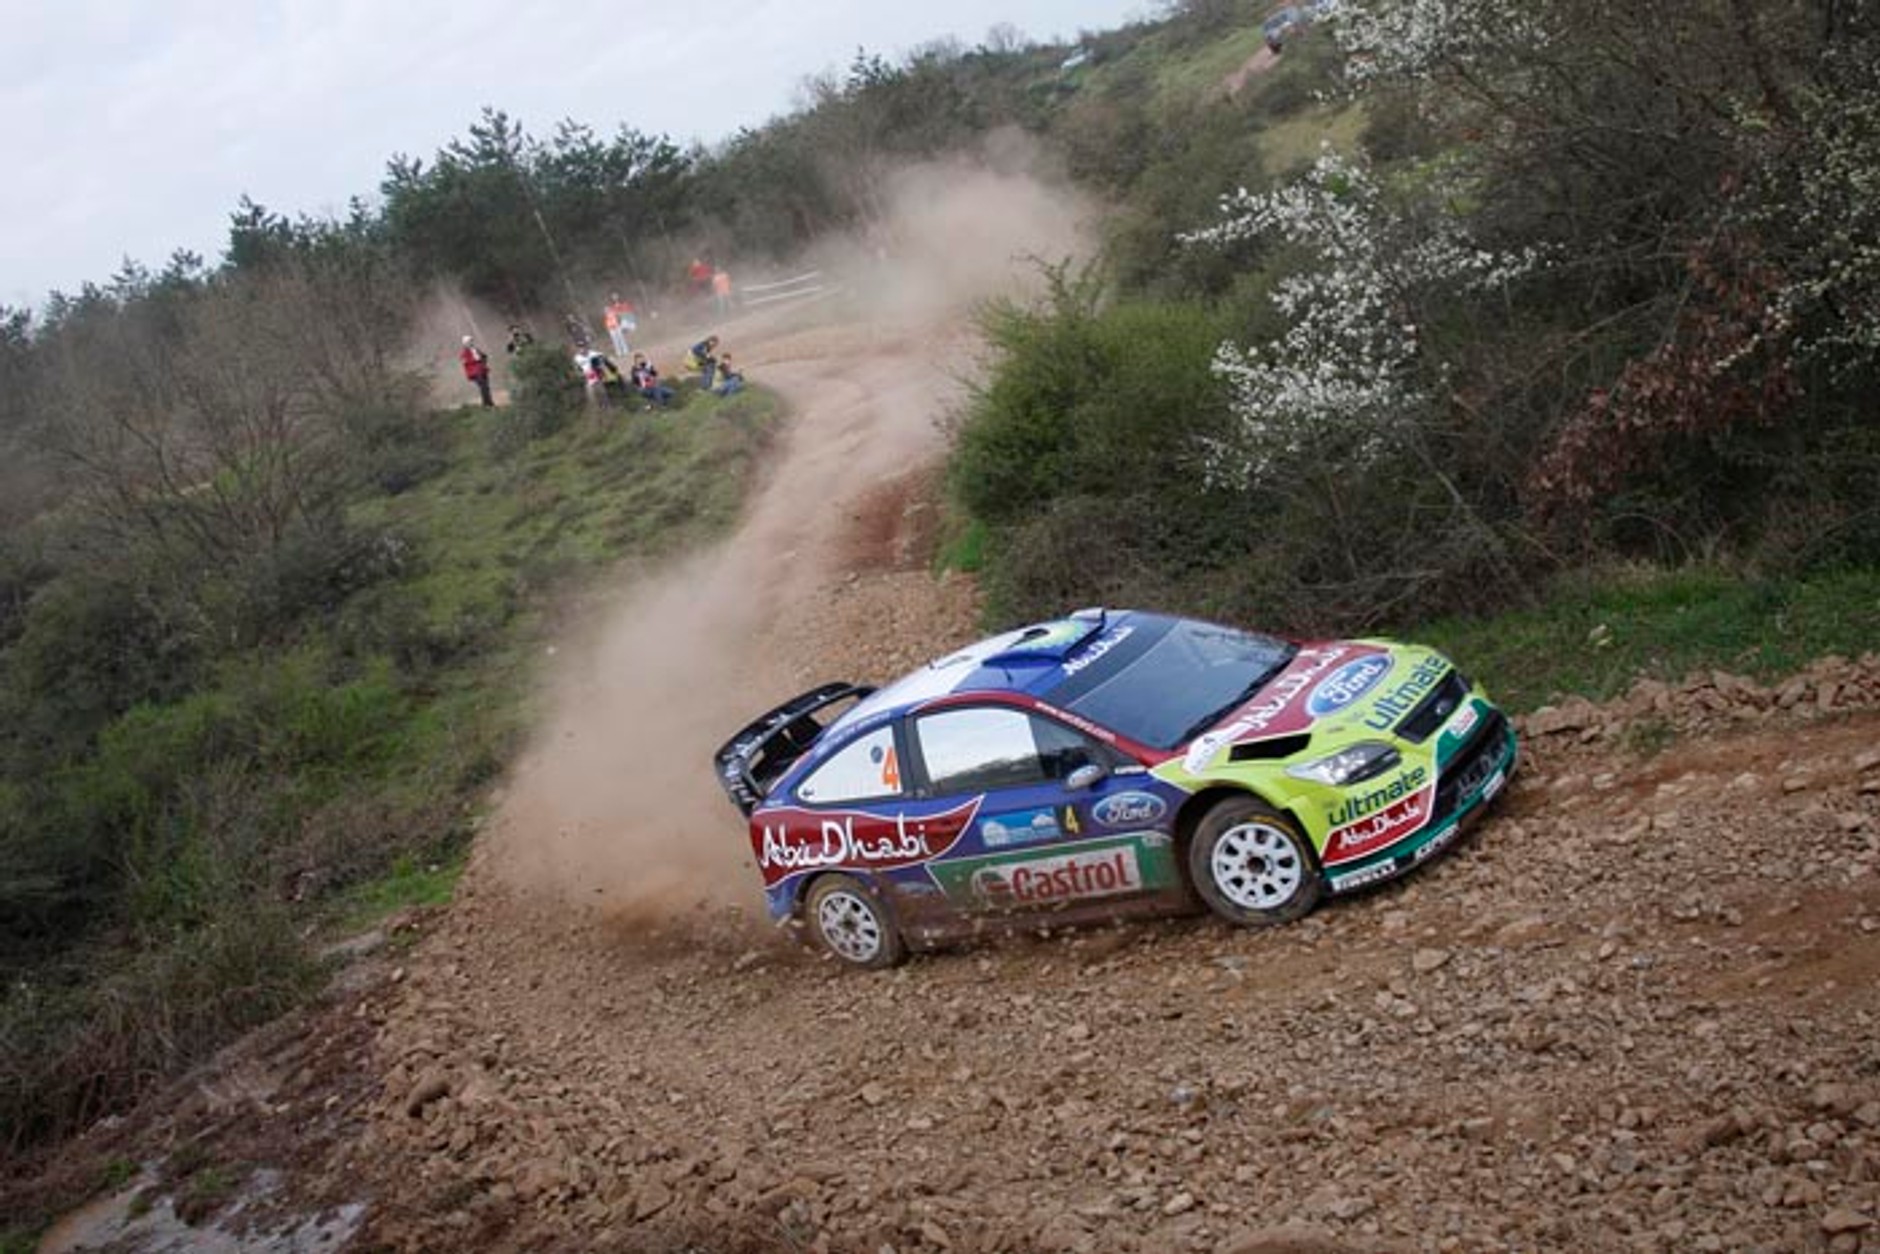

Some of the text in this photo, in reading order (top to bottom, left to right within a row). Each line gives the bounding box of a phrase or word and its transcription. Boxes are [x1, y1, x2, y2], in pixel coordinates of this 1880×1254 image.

[1322, 659, 1388, 704] Ford
[1364, 655, 1447, 731] ultimate
[881, 746, 899, 791] 4
[1065, 805, 1080, 834] 4
[1105, 797, 1154, 822] Ford
[1328, 767, 1426, 827] ultimate
[1012, 853, 1132, 900] Castrol
